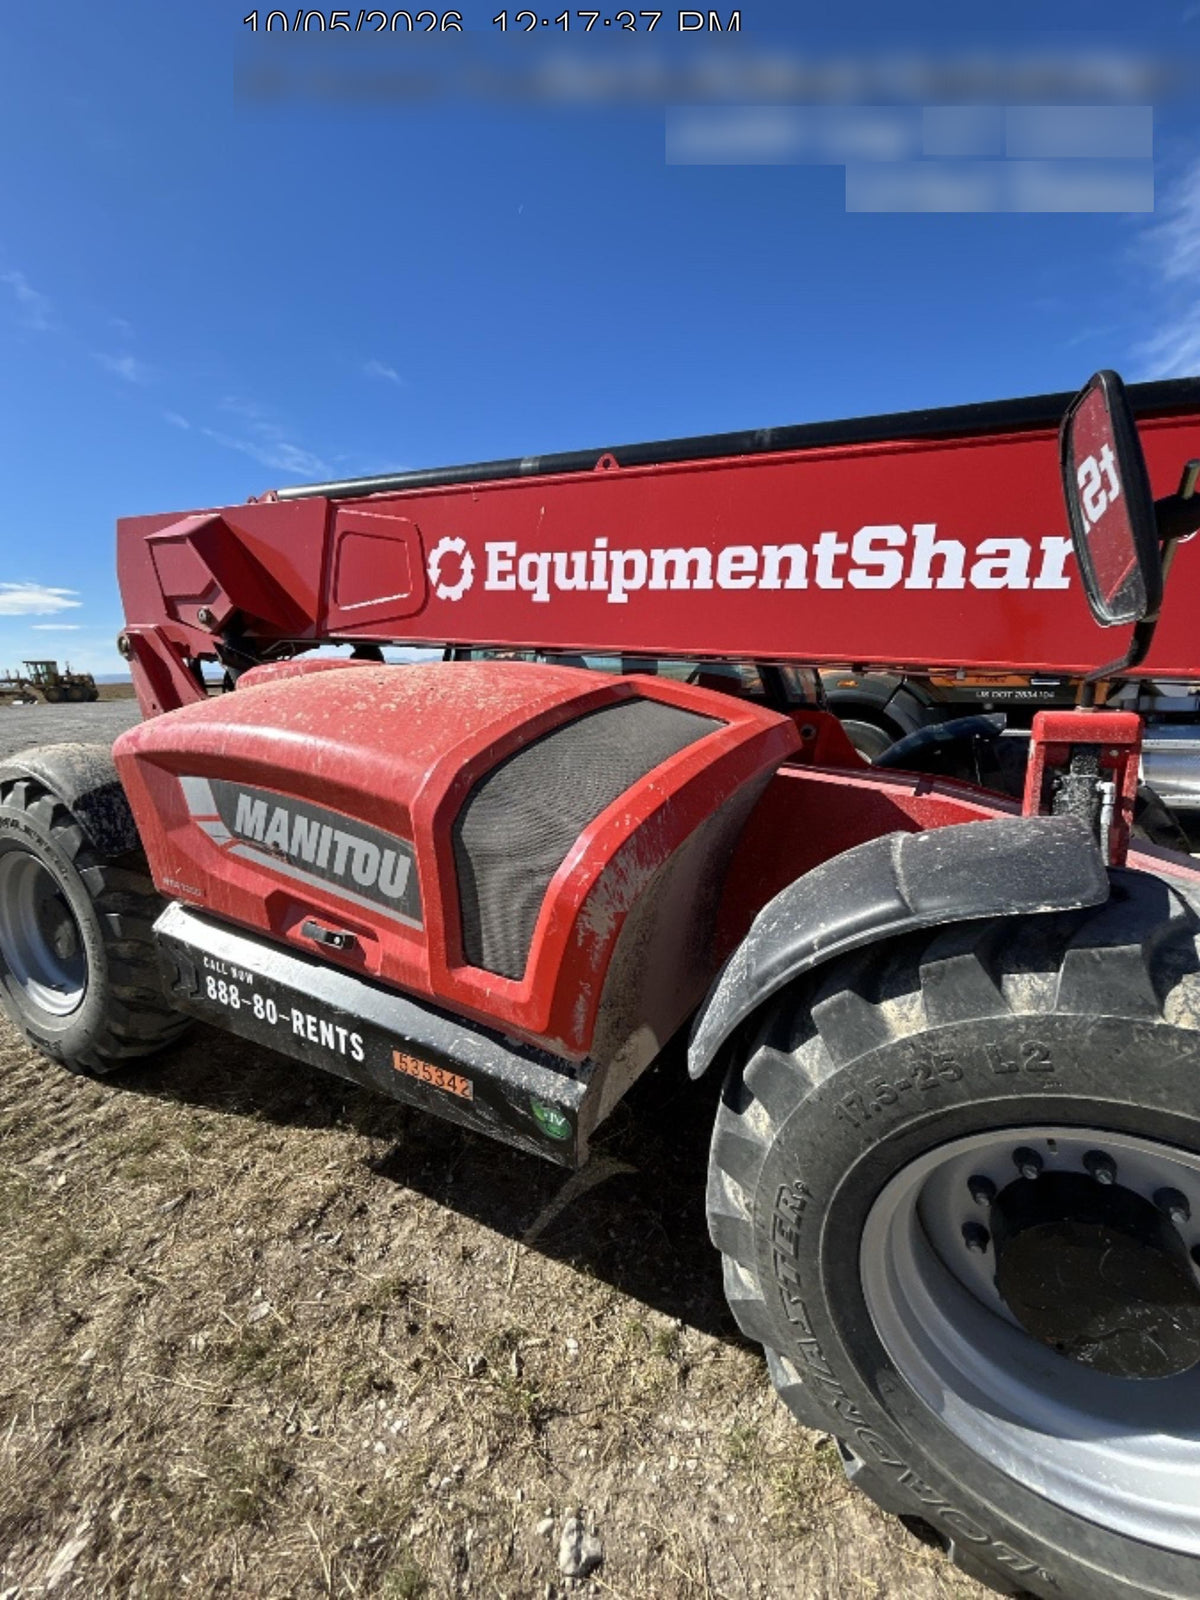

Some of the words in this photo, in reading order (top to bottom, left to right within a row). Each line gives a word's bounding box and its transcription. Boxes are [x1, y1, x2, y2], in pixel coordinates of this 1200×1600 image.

[485, 523, 1074, 604] EquipmentShar
[992, 690, 1013, 699] DOT
[234, 793, 412, 898] MANITOU
[203, 957, 228, 975] CALL
[206, 976, 364, 1062] 888-80-RENTS
[833, 1051, 964, 1128] 17.5-25
